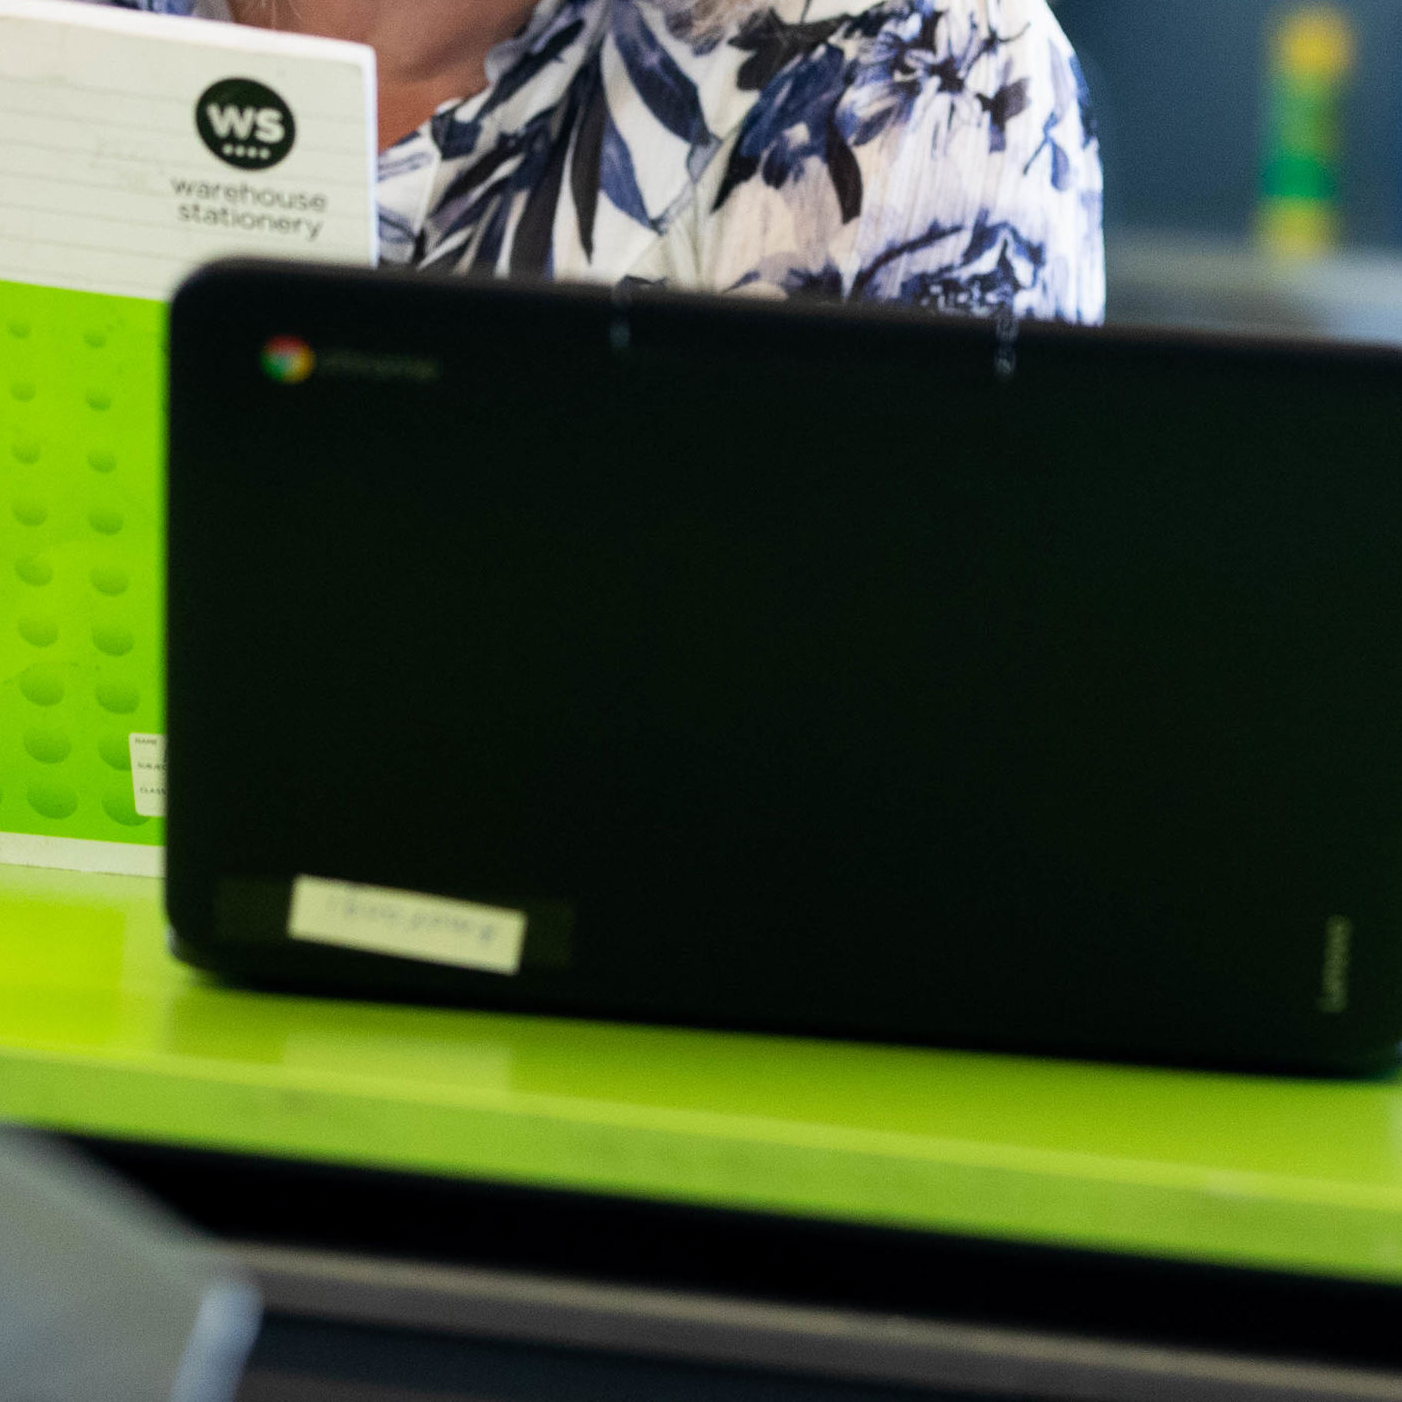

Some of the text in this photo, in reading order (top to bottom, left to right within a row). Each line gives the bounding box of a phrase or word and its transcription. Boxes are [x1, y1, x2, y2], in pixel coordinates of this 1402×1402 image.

[205, 102, 286, 144] WS
[169, 176, 329, 212] warehouse
[176, 202, 324, 241] stationery
